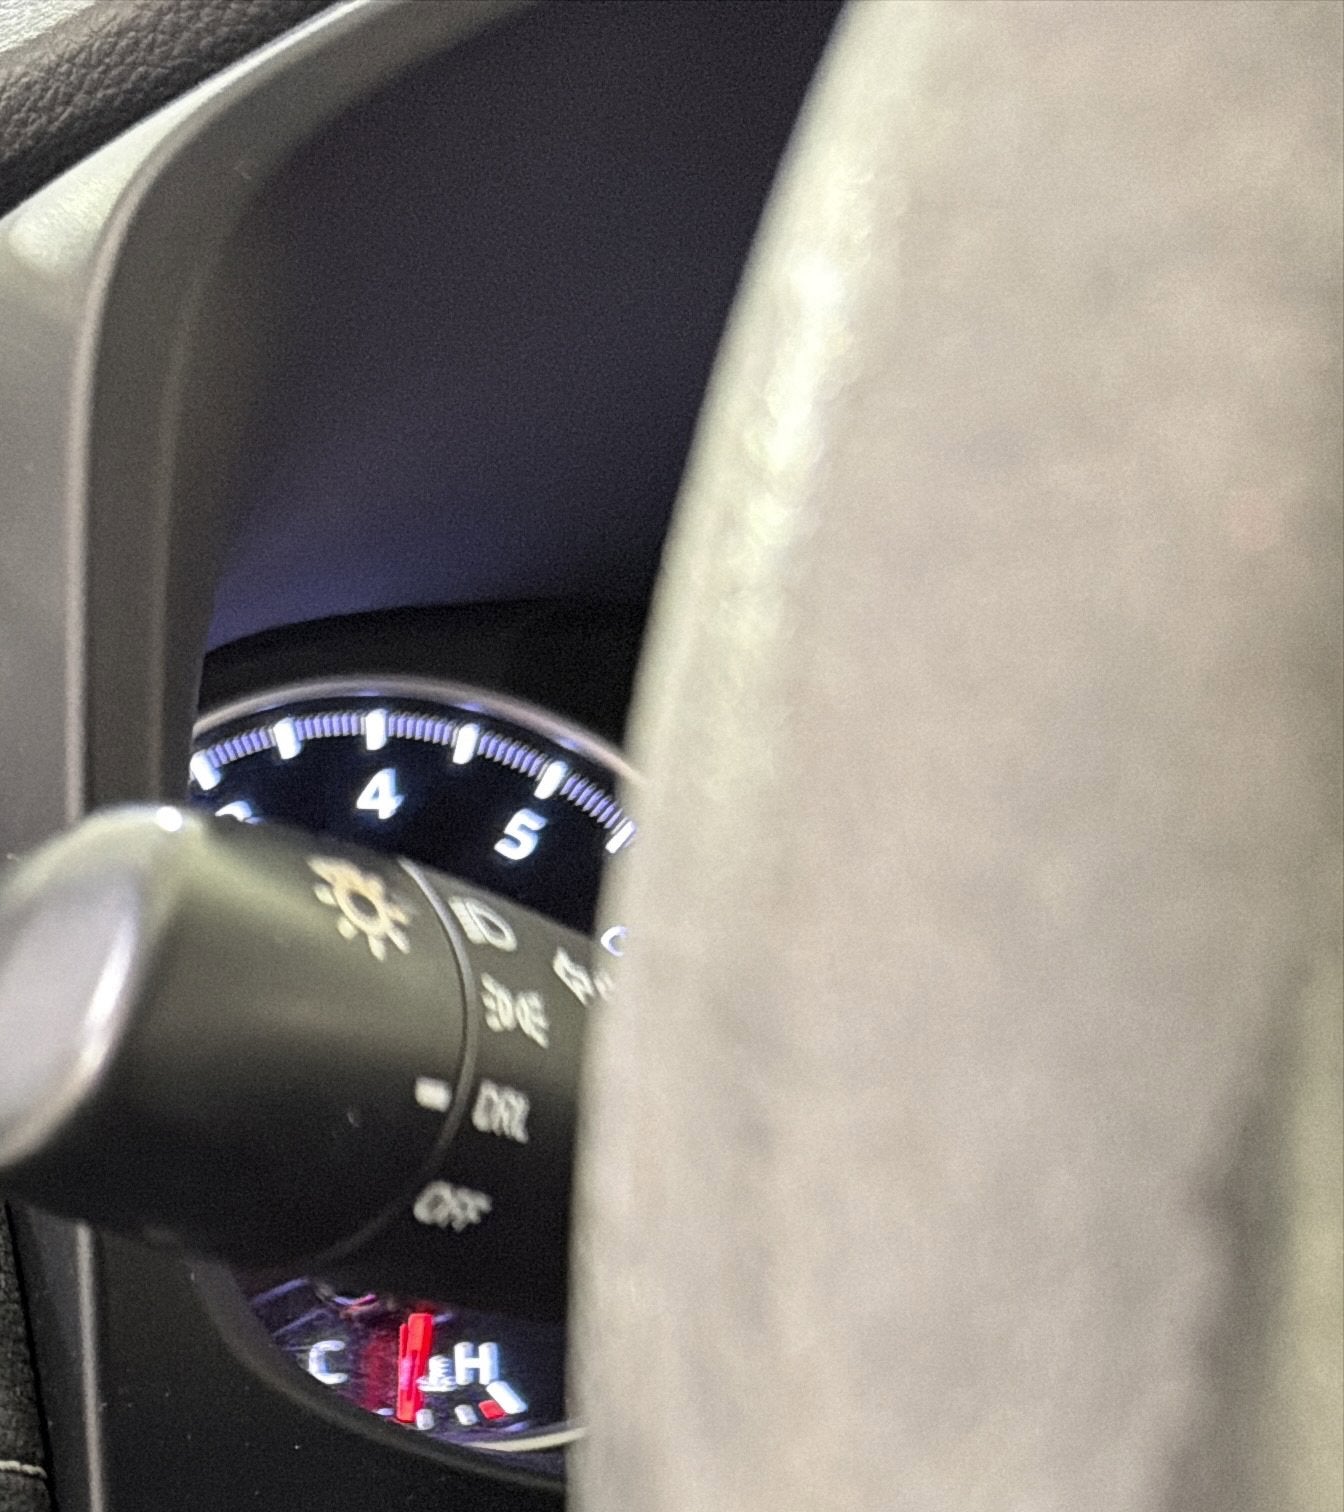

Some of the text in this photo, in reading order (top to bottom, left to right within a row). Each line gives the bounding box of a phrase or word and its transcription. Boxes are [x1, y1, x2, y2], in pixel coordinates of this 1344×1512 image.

[356, 768, 403, 819] 4
[494, 808, 547, 861] 5
[413, 1181, 491, 1231] OFF
[308, 1340, 349, 1385] C
[454, 1342, 499, 1385] H
